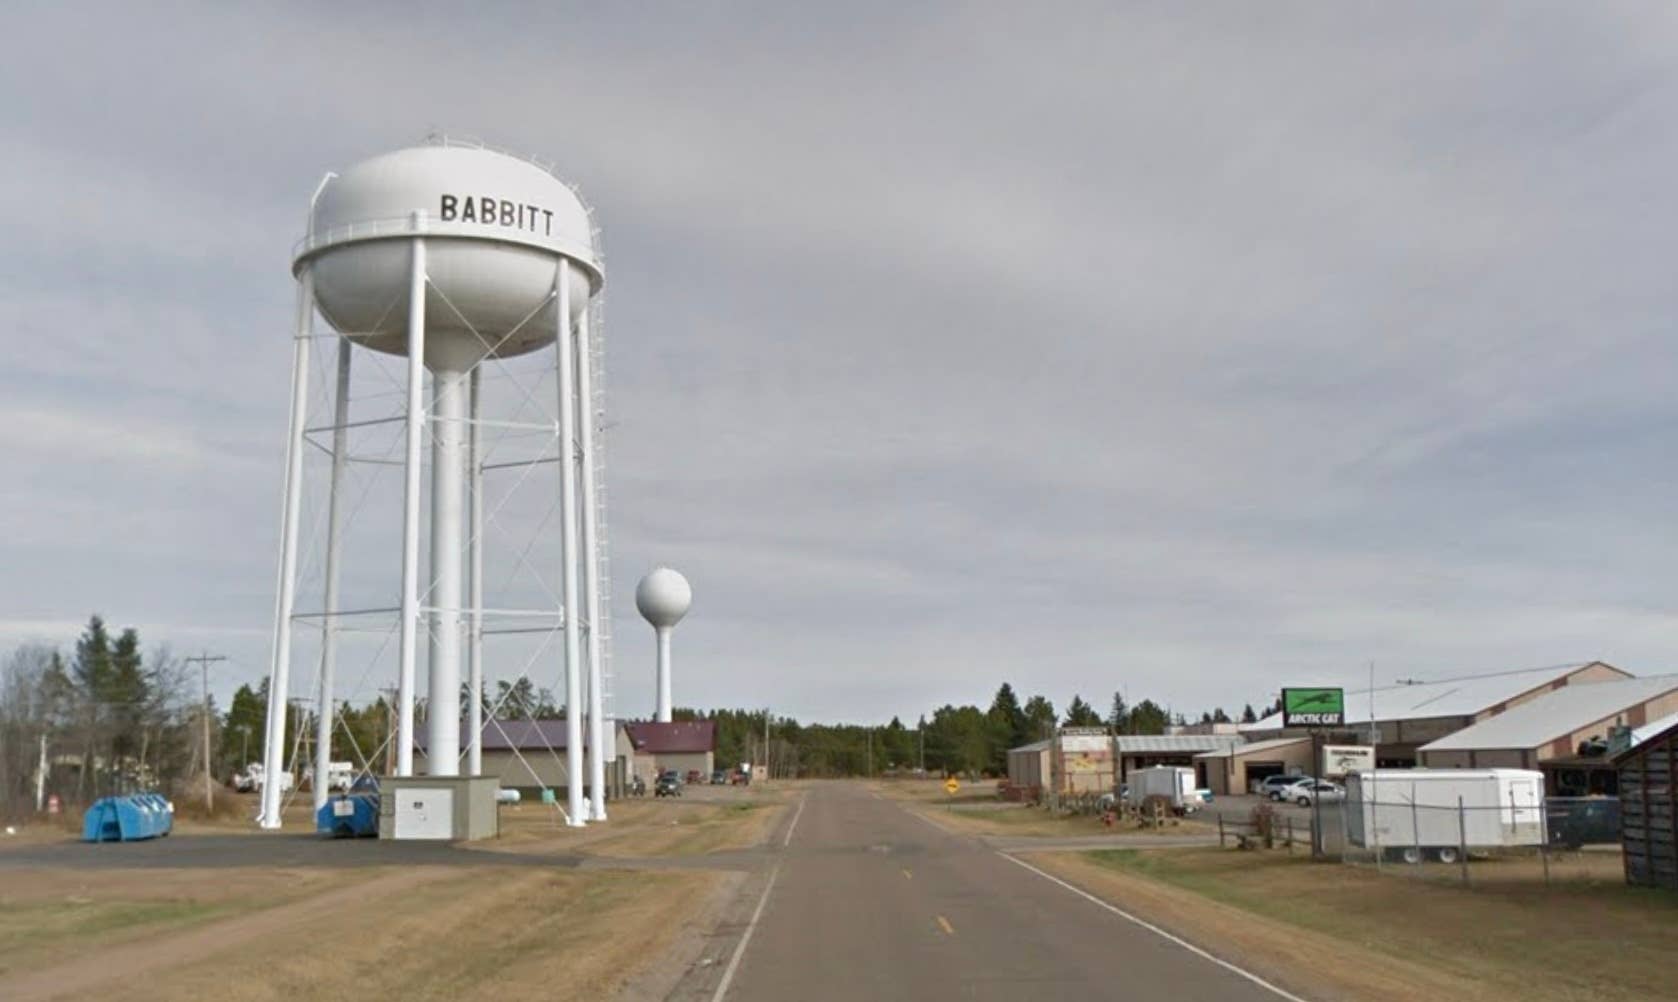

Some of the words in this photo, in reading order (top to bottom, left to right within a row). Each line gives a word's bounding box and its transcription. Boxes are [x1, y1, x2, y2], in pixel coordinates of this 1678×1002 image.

[441, 194, 553, 236] BABBITT
[1288, 713, 1320, 724] ARCTIC
[1321, 713, 1340, 724] CAT
